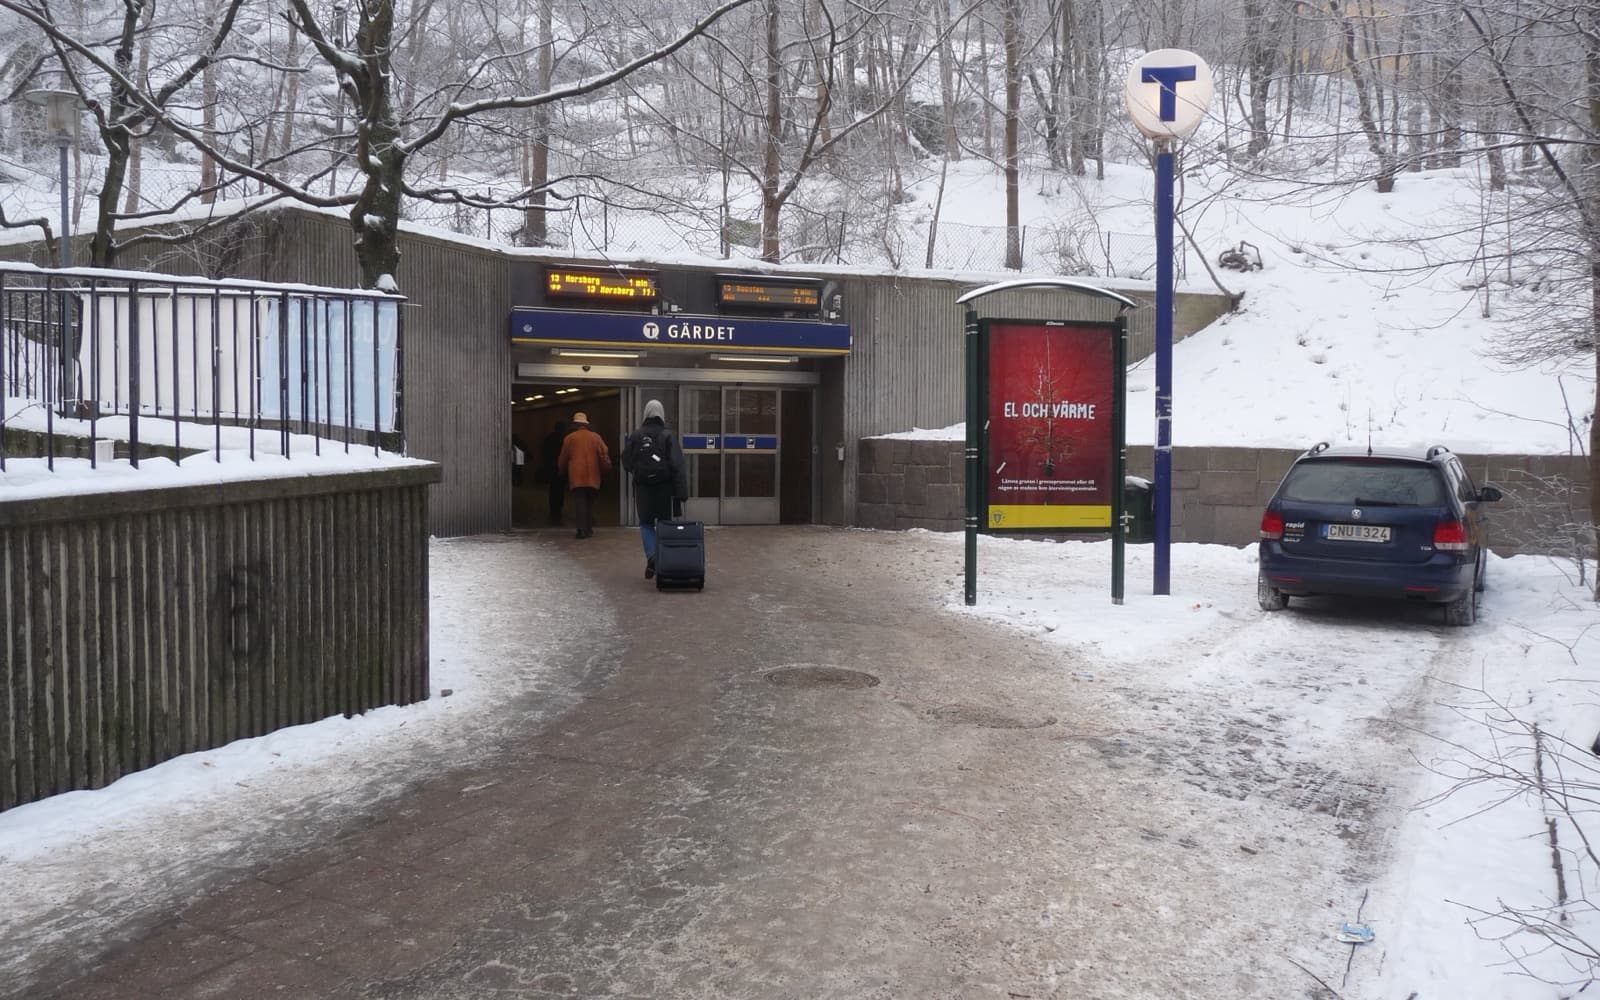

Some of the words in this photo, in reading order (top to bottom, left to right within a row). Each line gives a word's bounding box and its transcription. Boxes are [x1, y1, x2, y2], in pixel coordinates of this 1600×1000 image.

[1141, 65, 1196, 122] T
[668, 322, 735, 340] GÄRDET
[1004, 402, 1018, 418] EL
[1022, 403, 1049, 418] OCH
[1052, 400, 1096, 420] VÄRME
[1329, 525, 1354, 537] CNU
[1363, 527, 1387, 539] 324
